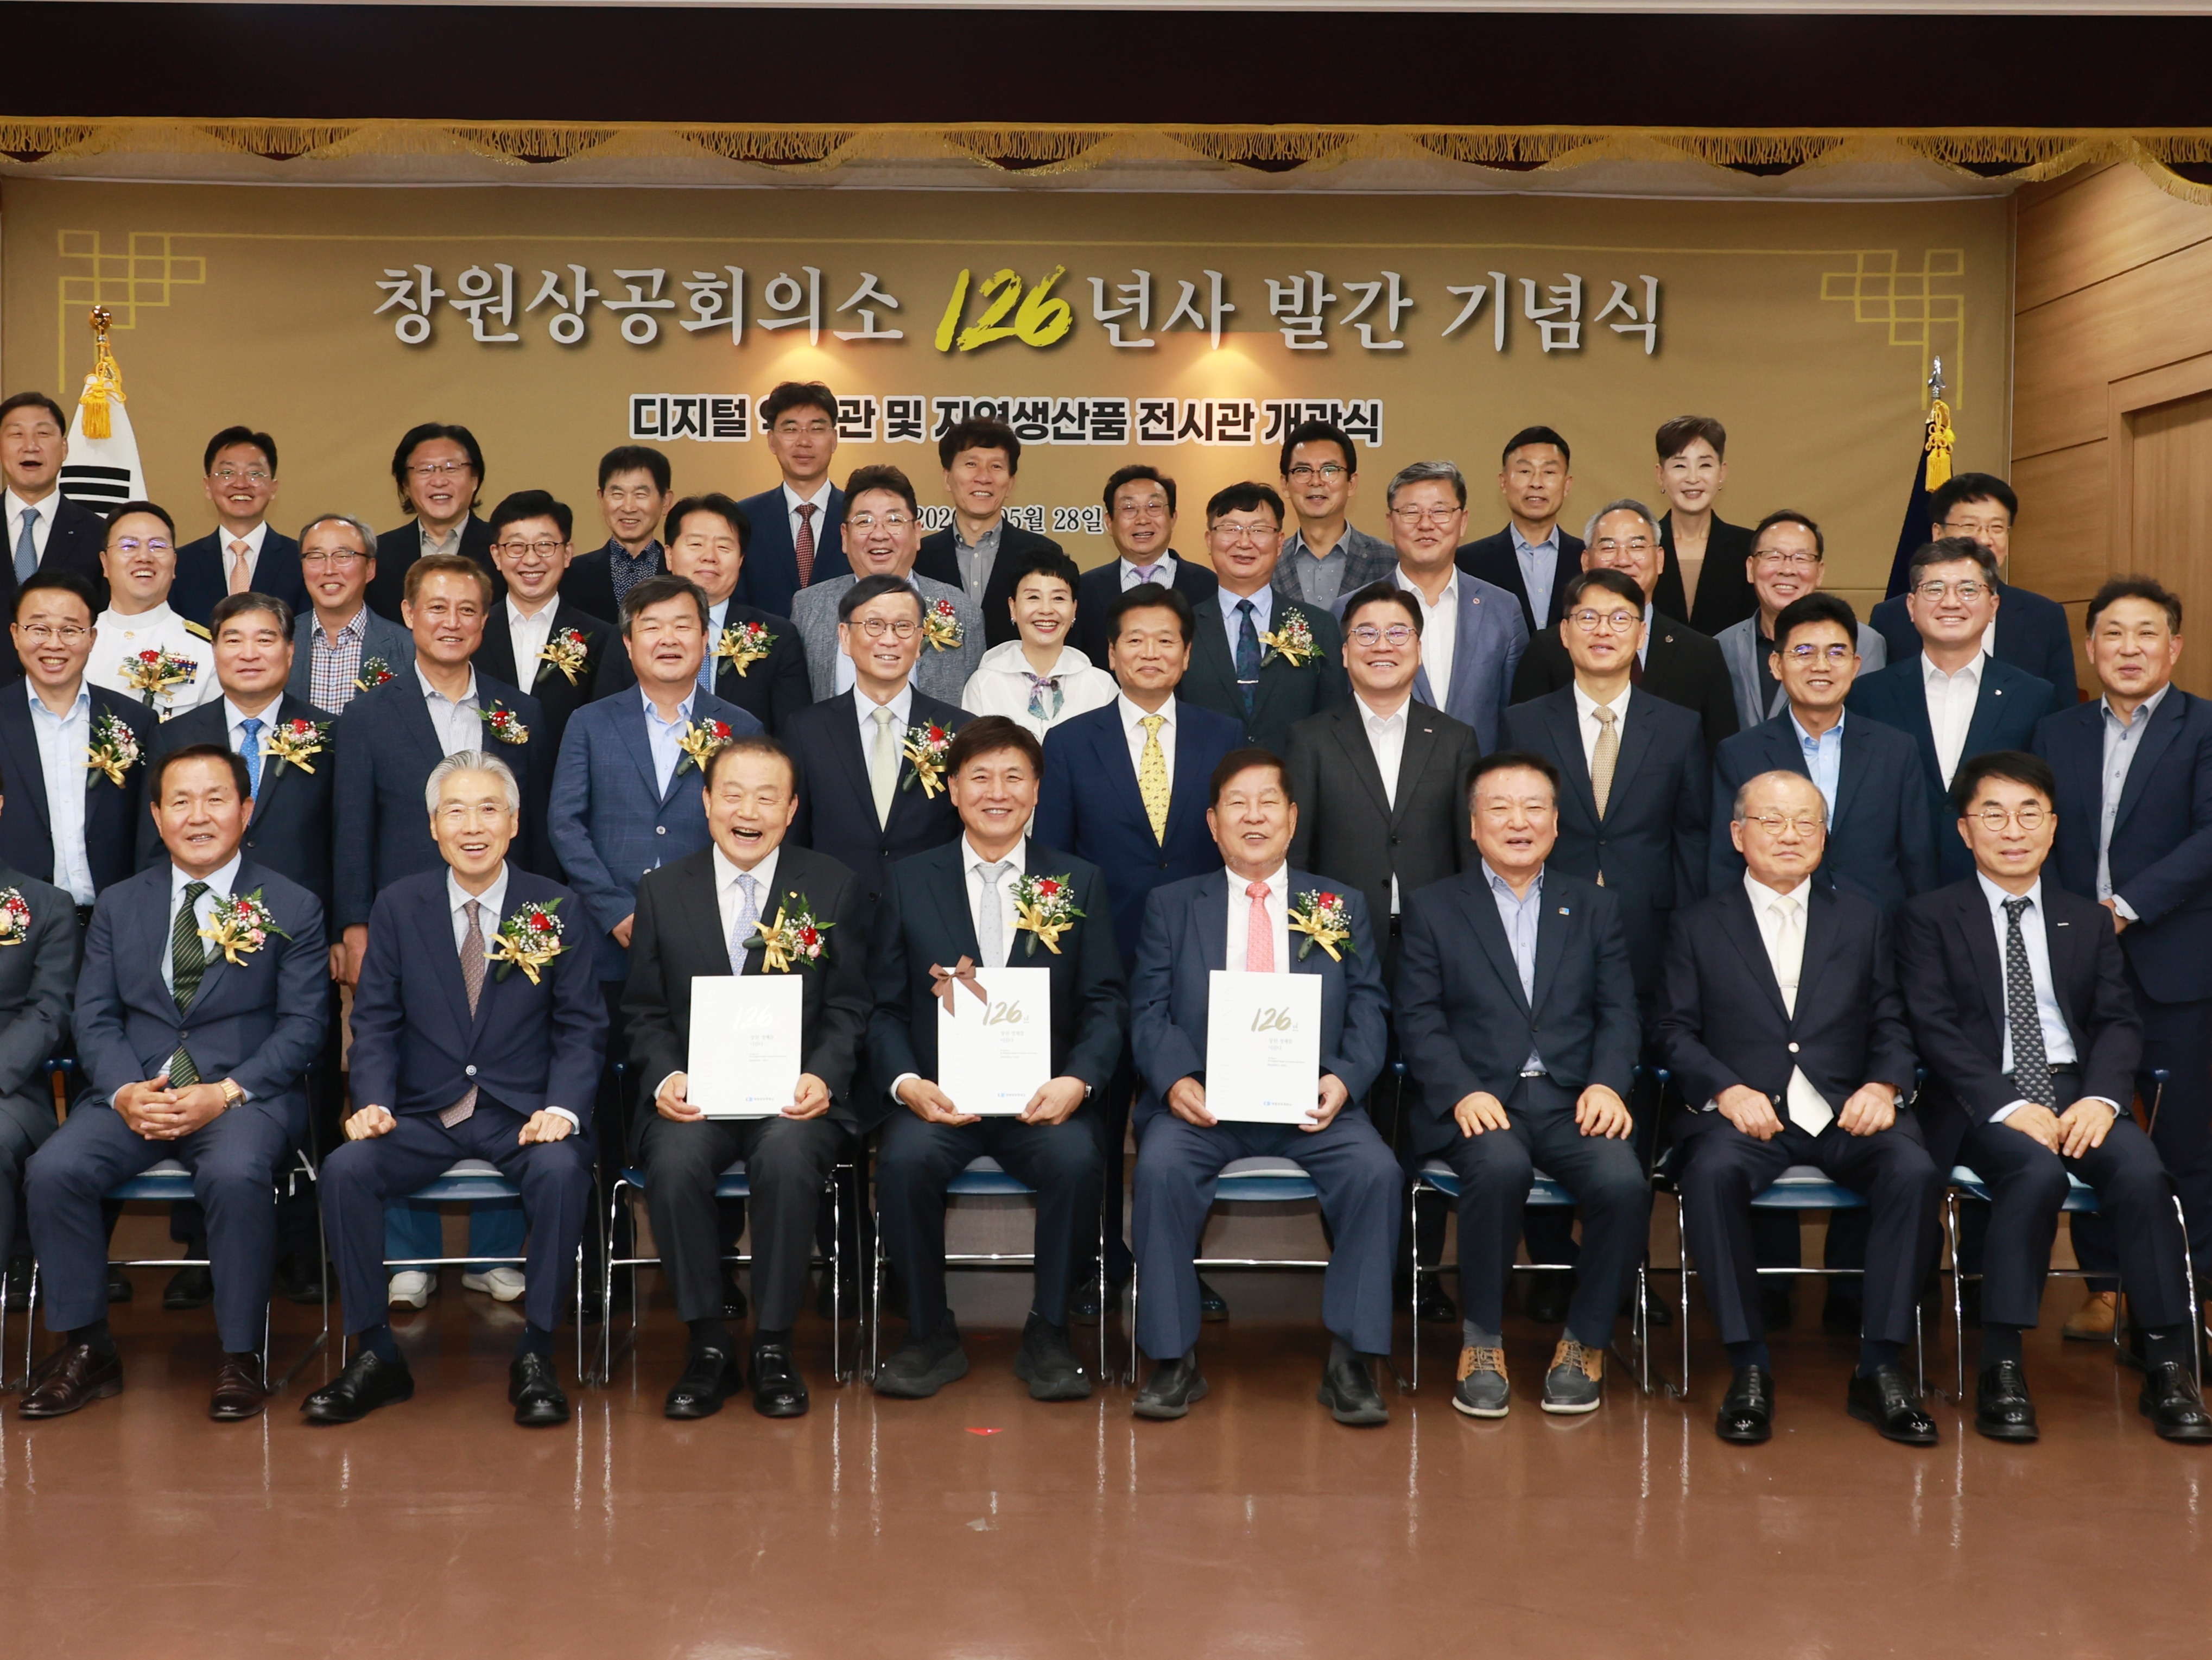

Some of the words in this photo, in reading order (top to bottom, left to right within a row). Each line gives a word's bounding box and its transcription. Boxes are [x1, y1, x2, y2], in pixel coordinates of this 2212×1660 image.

[373, 262, 904, 347] 창원상공회의소
[1264, 270, 1414, 350] 발간
[1441, 271, 1660, 355] 기념식
[633, 397, 747, 438] 디지털
[887, 400, 923, 439] 및
[1139, 402, 1255, 441] 전시관
[1054, 507, 1102, 532] 28일
[982, 999, 1023, 1026] 126
[1251, 1006, 1291, 1032] 126
